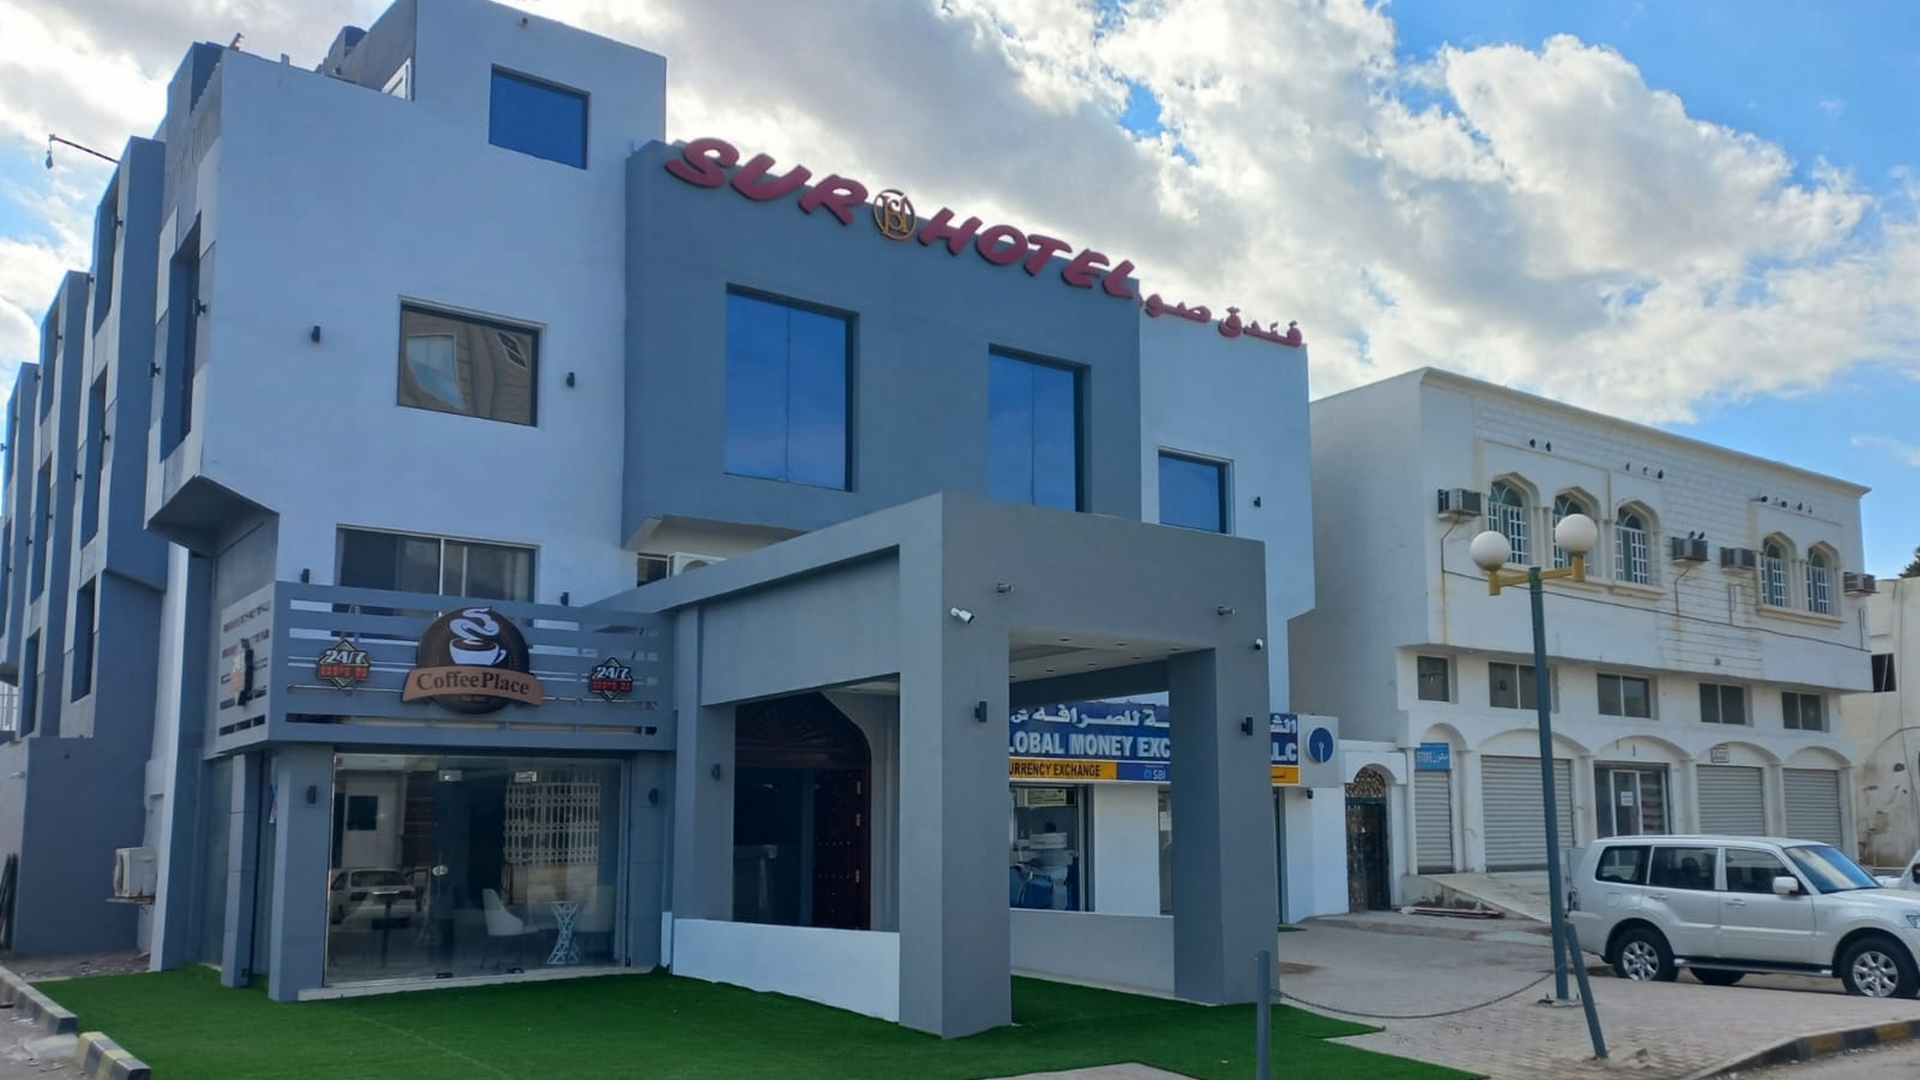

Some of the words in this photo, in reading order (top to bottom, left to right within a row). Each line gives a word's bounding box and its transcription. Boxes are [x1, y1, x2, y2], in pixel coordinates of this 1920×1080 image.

[664, 137, 869, 225] SUR
[917, 207, 1138, 300] HOTEL
[1218, 307, 1302, 347] فندق
[325, 650, 366, 664] 24/7
[416, 671, 479, 691] Coffee
[481, 672, 529, 695] Place
[597, 666, 630, 679] 24/7
[1068, 734, 1133, 757] MONEY
[1137, 737, 1170, 758] EXC
[1271, 742, 1297, 761] LC
[1009, 758, 1050, 775] URRENCY
[1053, 762, 1101, 777] EXCHANGE
[1152, 770, 1166, 780] SBI
